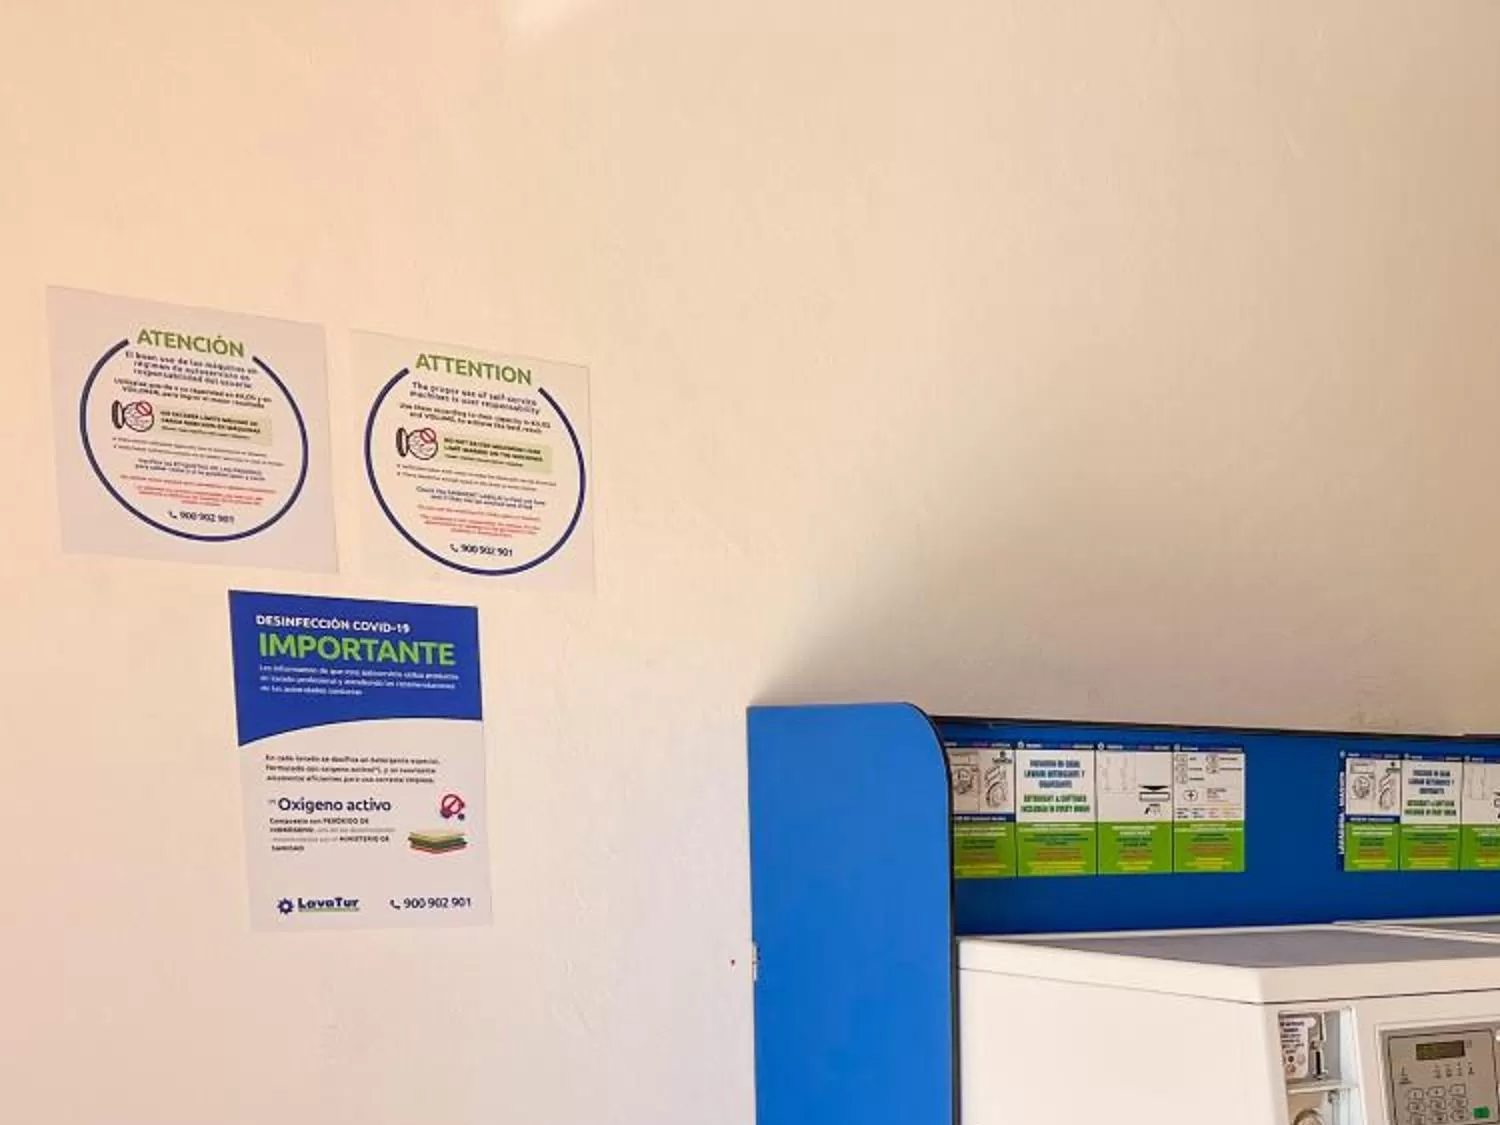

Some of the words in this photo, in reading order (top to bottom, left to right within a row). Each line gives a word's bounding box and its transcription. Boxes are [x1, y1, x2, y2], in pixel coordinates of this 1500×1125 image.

[137, 329, 244, 357] ATENCIÓN
[415, 353, 532, 386] ATTENTION
[412, 381, 428, 390] The
[497, 546, 513, 557] 901
[256, 615, 349, 630] DESINFECCIÓN
[353, 620, 410, 633] COVID-19
[259, 632, 456, 665] IMPORTANTE
[347, 796, 391, 811] activo
[298, 896, 359, 909] LavaTur
[404, 897, 426, 909] 900
[428, 897, 449, 909] 902
[451, 897, 472, 908] 901
